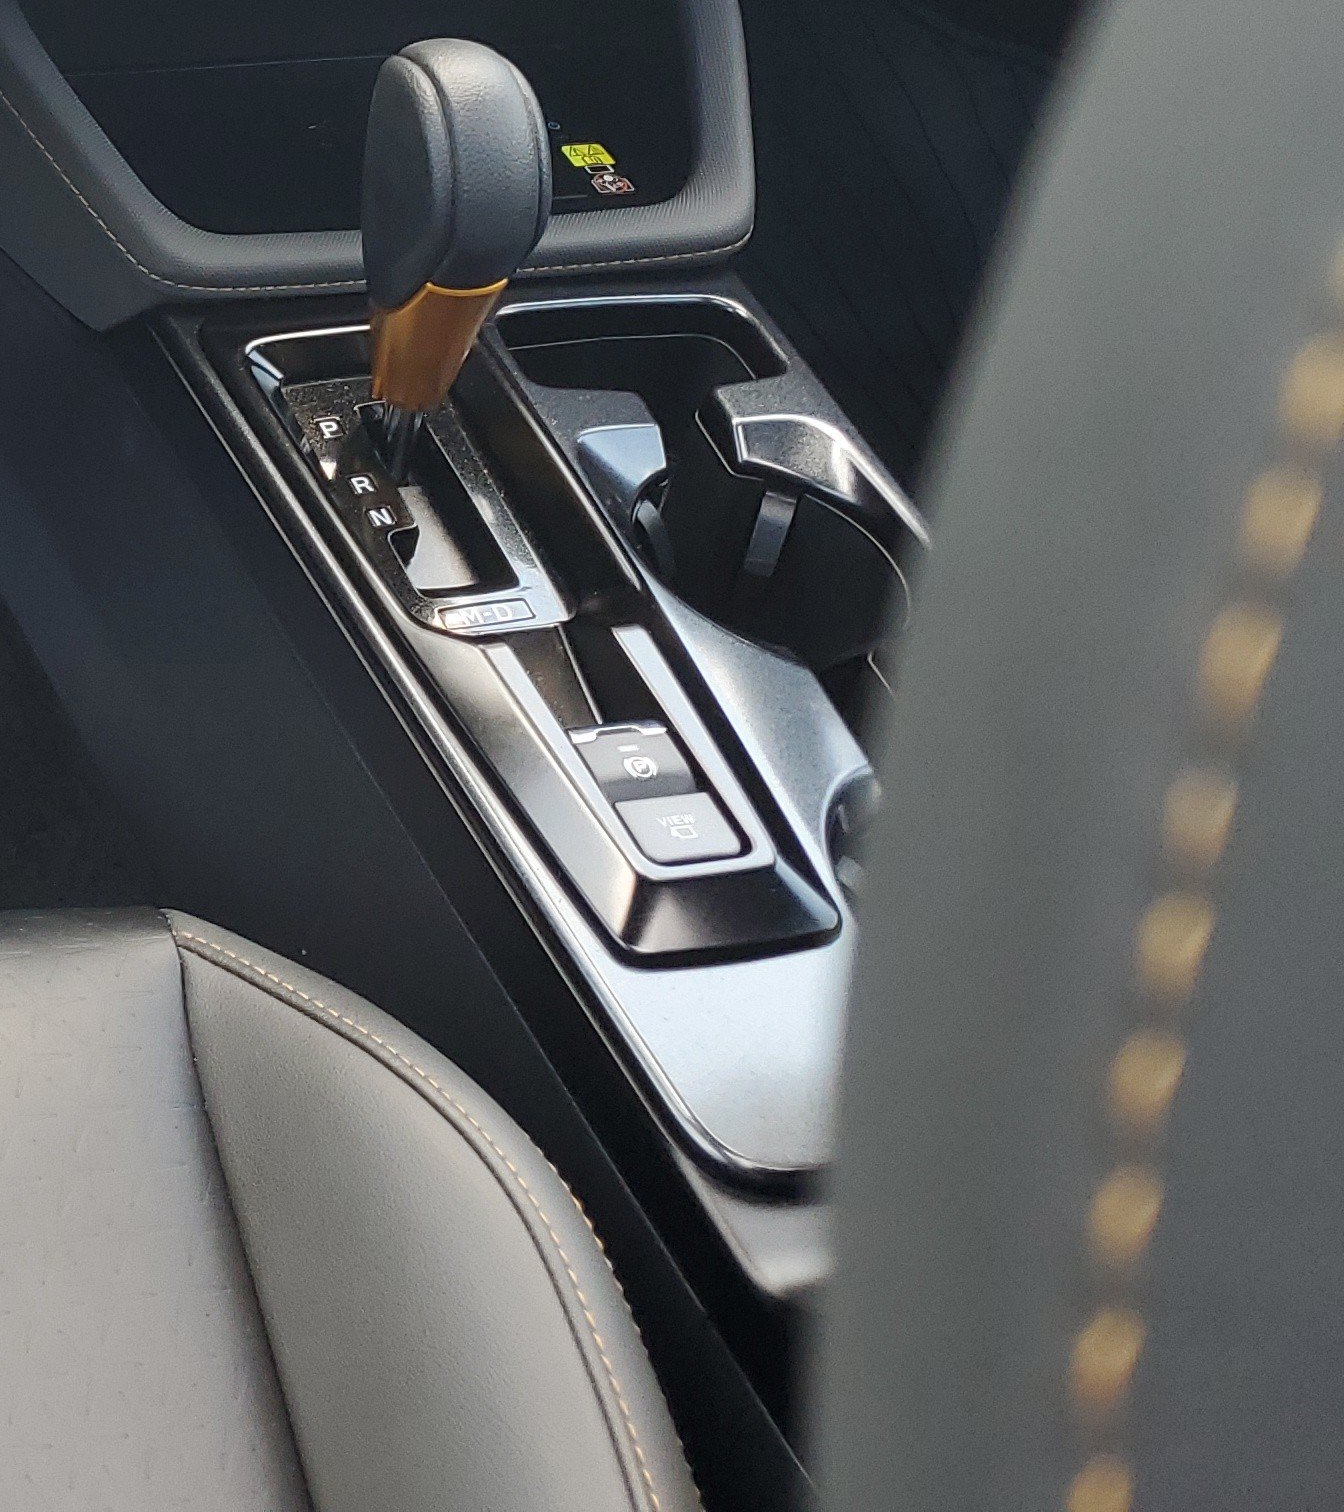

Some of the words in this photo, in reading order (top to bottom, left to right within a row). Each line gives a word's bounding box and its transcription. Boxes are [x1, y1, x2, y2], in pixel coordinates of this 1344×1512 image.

[319, 421, 339, 439] P
[350, 476, 375, 494] R
[368, 508, 396, 527] N
[656, 814, 696, 827] VIEW
